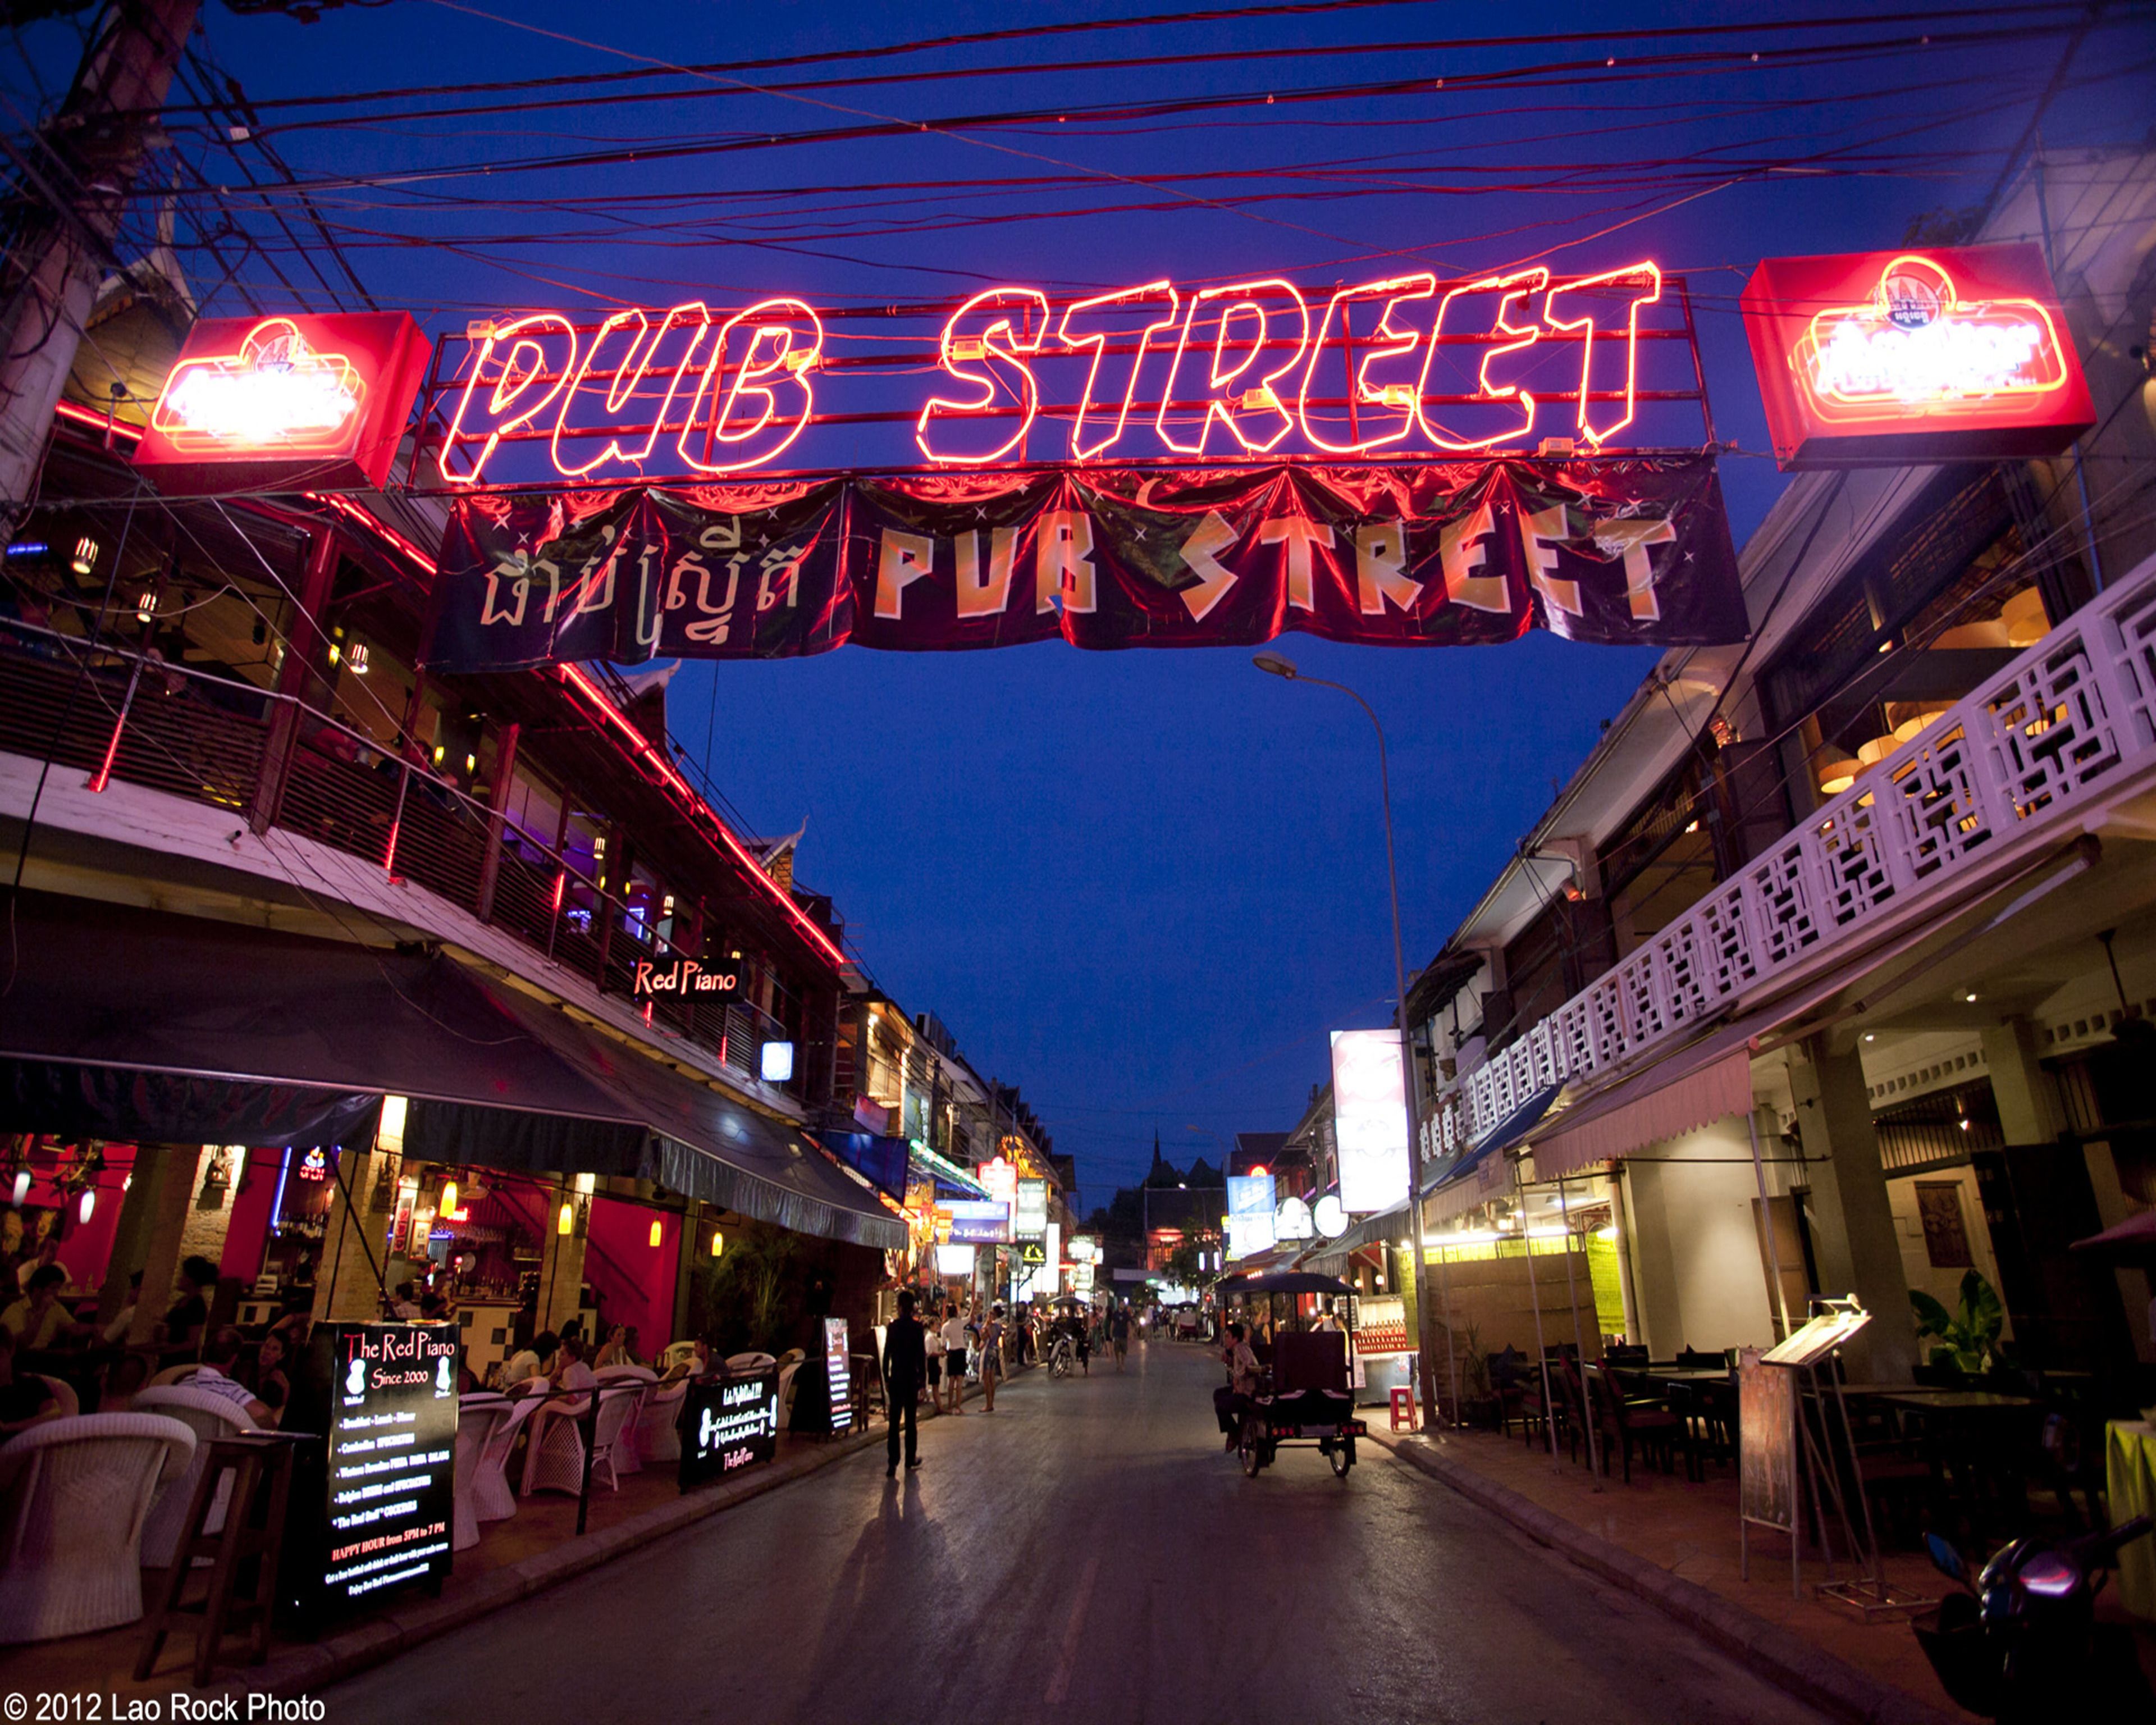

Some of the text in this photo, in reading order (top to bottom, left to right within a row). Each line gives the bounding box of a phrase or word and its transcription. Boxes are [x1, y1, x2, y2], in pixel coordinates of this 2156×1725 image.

[439, 259, 1661, 482] PUB STREET
[874, 502, 1678, 622] PUB STREET
[634, 959, 737, 995] Red Piano
[344, 1331, 455, 1363] The Red Piano
[371, 1368, 429, 1389] Since 2000
[332, 1543, 361, 1561] HAPPY
[362, 1536, 385, 1553] HOUR
[420, 1527, 427, 1537] to
[428, 1524, 433, 1535] 7
